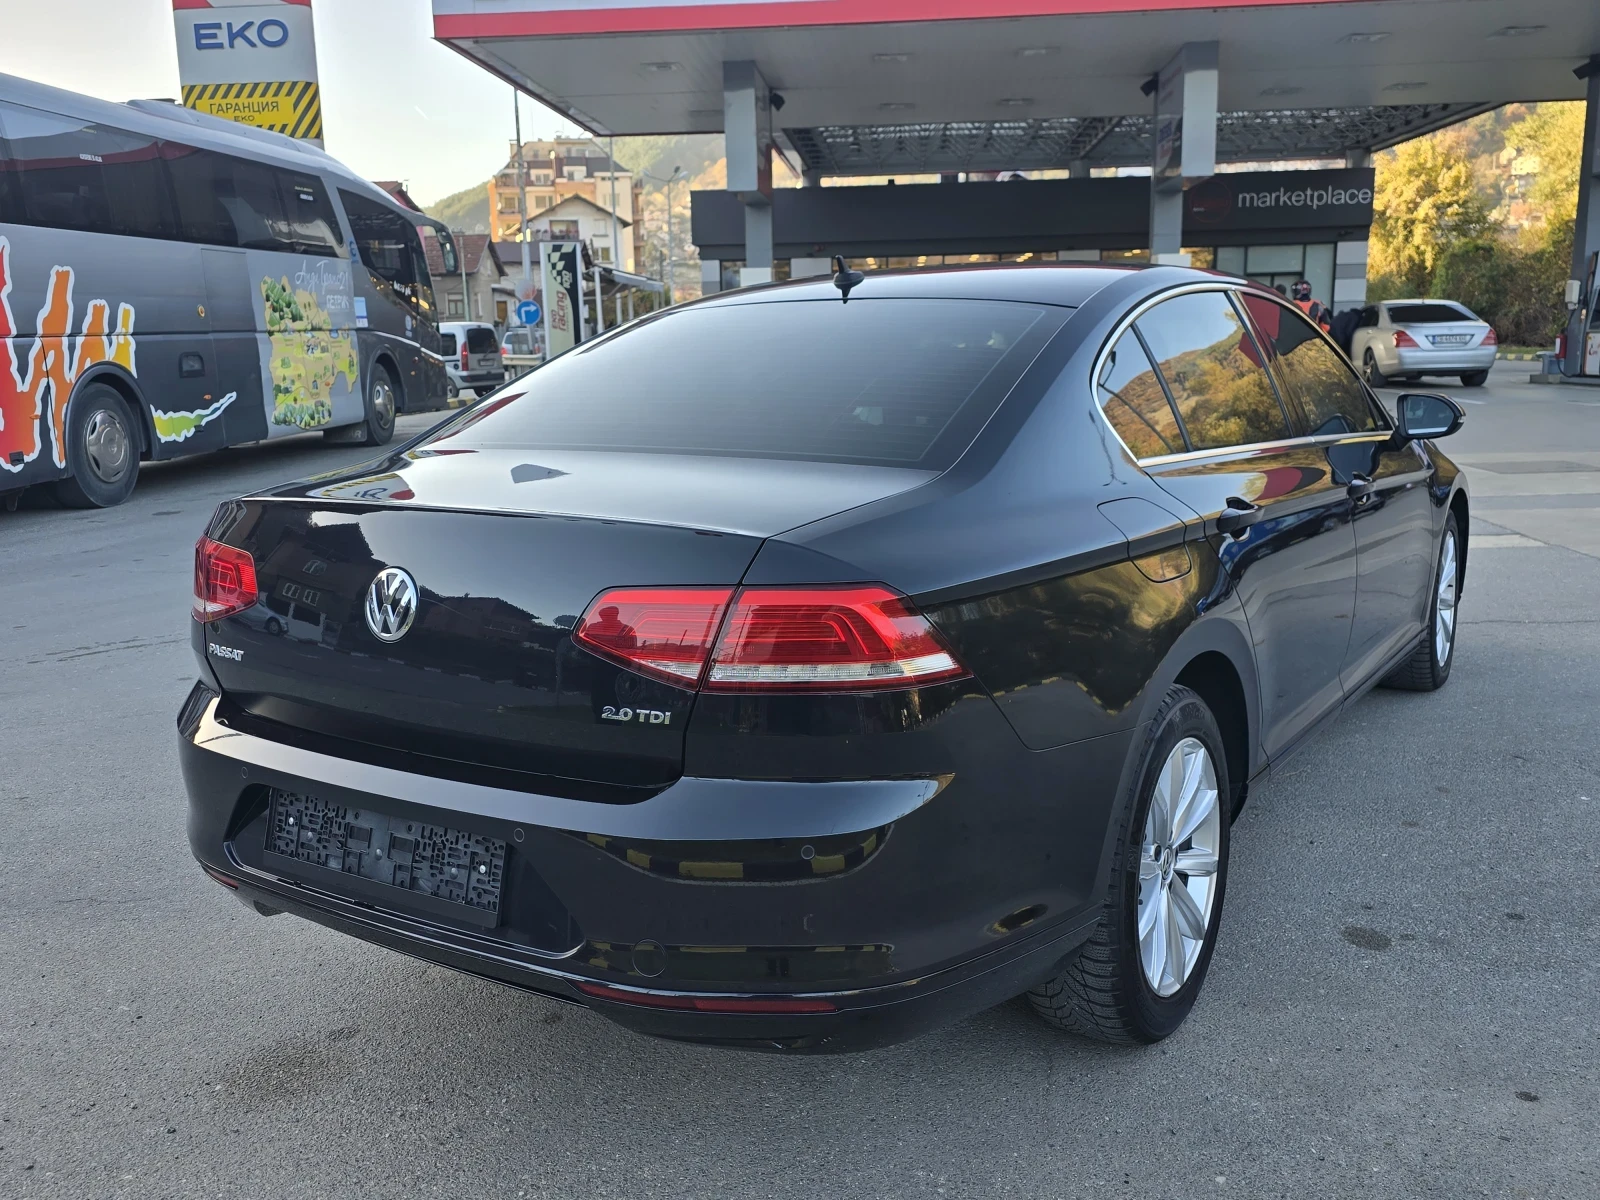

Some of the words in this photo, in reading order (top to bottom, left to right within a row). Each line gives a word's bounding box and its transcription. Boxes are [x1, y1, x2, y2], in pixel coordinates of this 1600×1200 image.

[193, 18, 289, 50] EKO
[209, 100, 280, 114] ГАРАНЦИЯ
[1237, 185, 1372, 210] marketplace
[557, 291, 567, 331] racing
[209, 642, 244, 661] PASSAT
[636, 709, 671, 725] TDI
